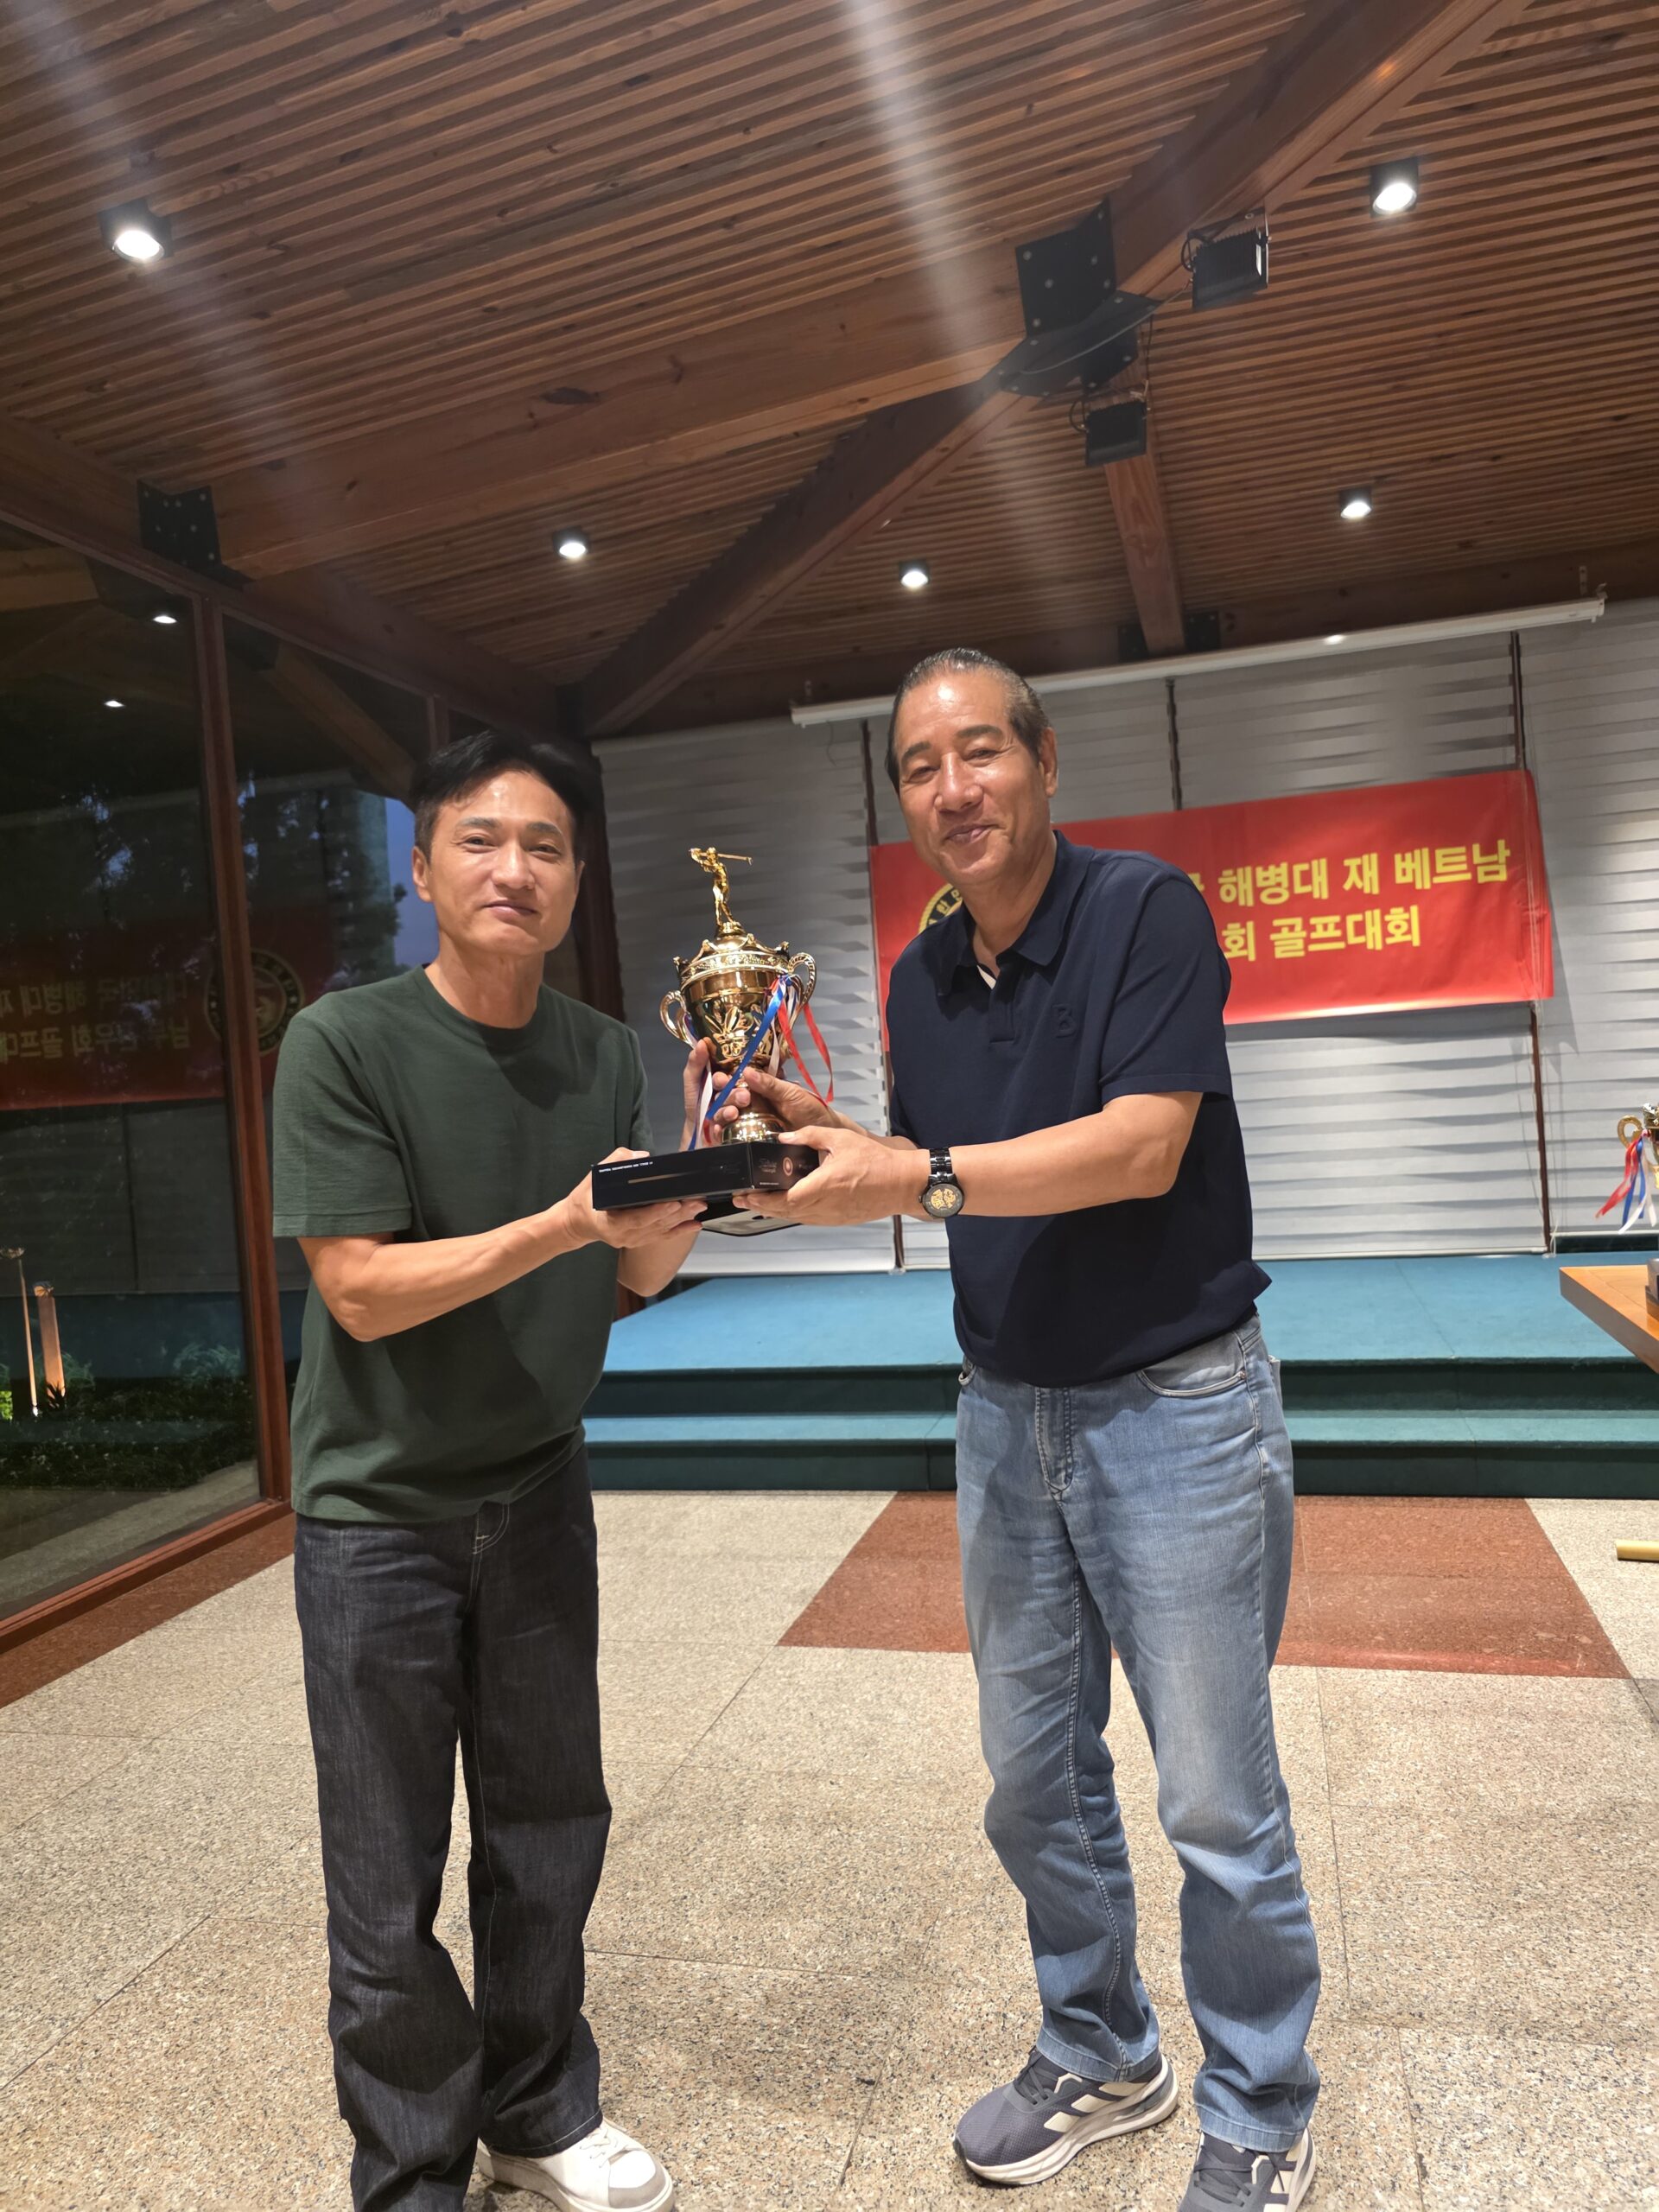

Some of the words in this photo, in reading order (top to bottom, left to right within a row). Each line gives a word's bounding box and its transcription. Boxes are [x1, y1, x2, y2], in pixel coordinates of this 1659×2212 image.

[1217, 858, 1329, 906] 해병대
[1343, 852, 1380, 895] 재
[1394, 839, 1510, 891] 베트남
[1269, 905, 1421, 959] 골프대회
